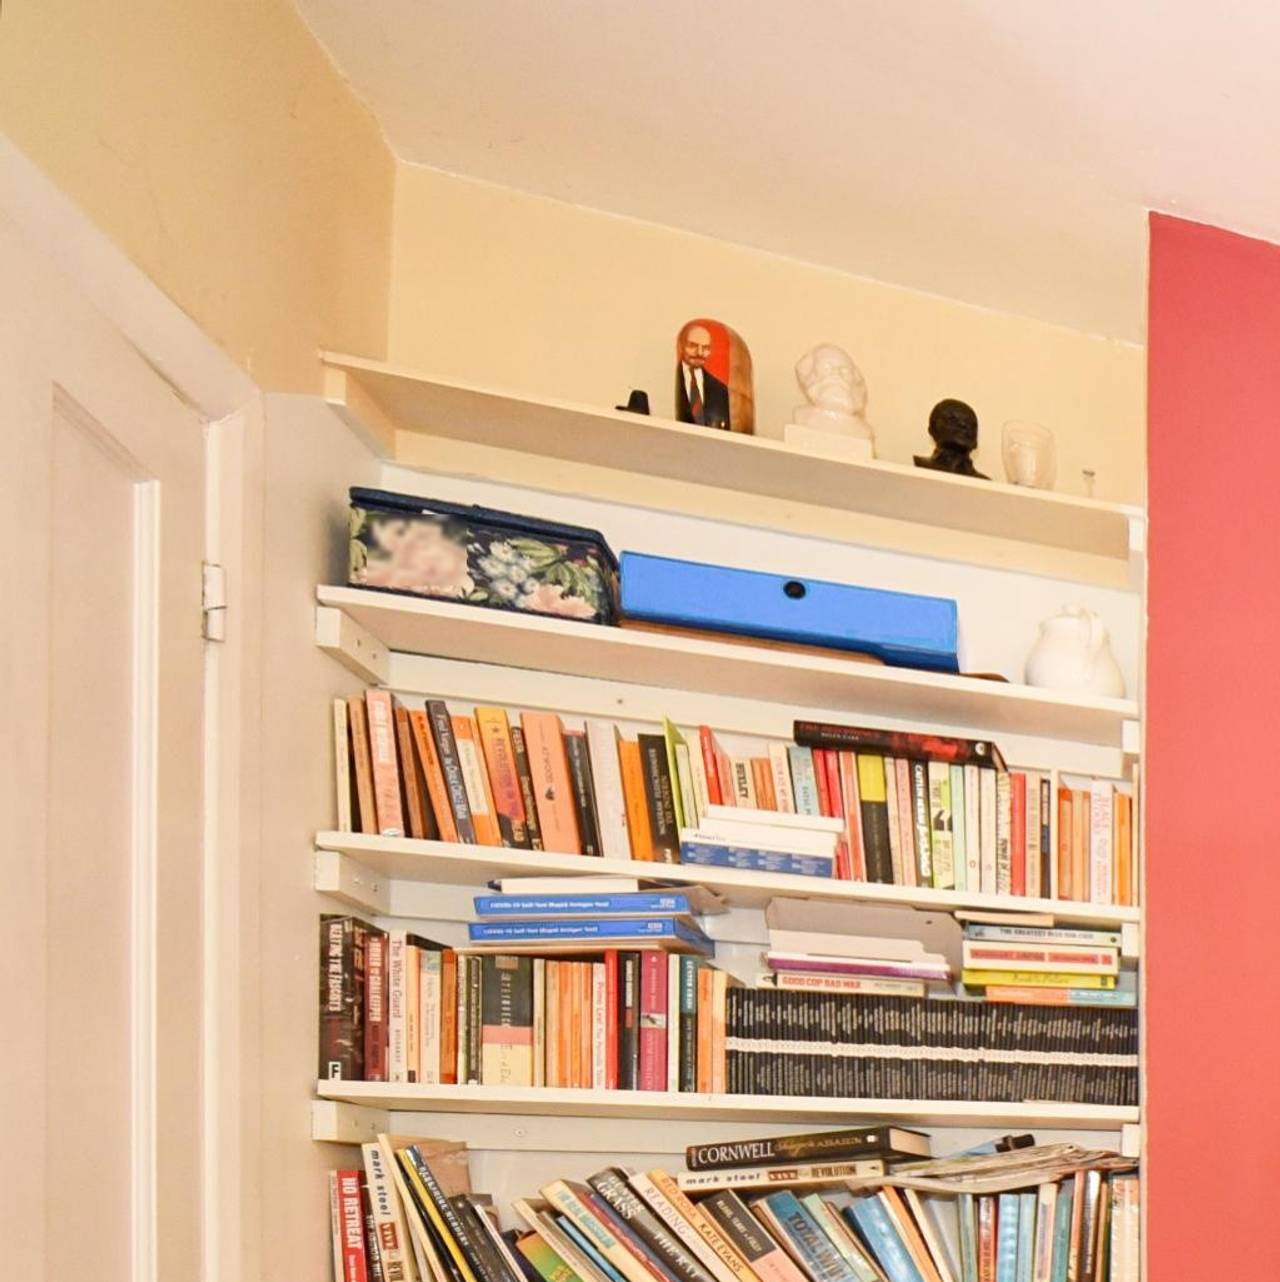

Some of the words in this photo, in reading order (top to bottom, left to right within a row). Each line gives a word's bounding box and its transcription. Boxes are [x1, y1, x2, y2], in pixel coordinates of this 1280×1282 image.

[735, 762, 749, 799] HUXLEY
[328, 922, 343, 957] BEATING
[391, 940, 403, 957] The
[328, 958, 343, 973] THE
[391, 959, 403, 988] White
[782, 976, 805, 986] GOOD
[390, 989, 402, 1019] Guard
[371, 1149, 386, 1180] mark
[698, 1141, 775, 1164] CORNWELL
[342, 1177, 357, 1194] NO
[686, 1175, 720, 1185] mark
[726, 1172, 761, 1183] steel
[811, 1164, 857, 1177] REVOLUTION
[376, 1185, 391, 1216] steel
[597, 1182, 637, 1220] GRASS
[643, 1186, 690, 1235] READING
[343, 1197, 363, 1249] RETREAT
